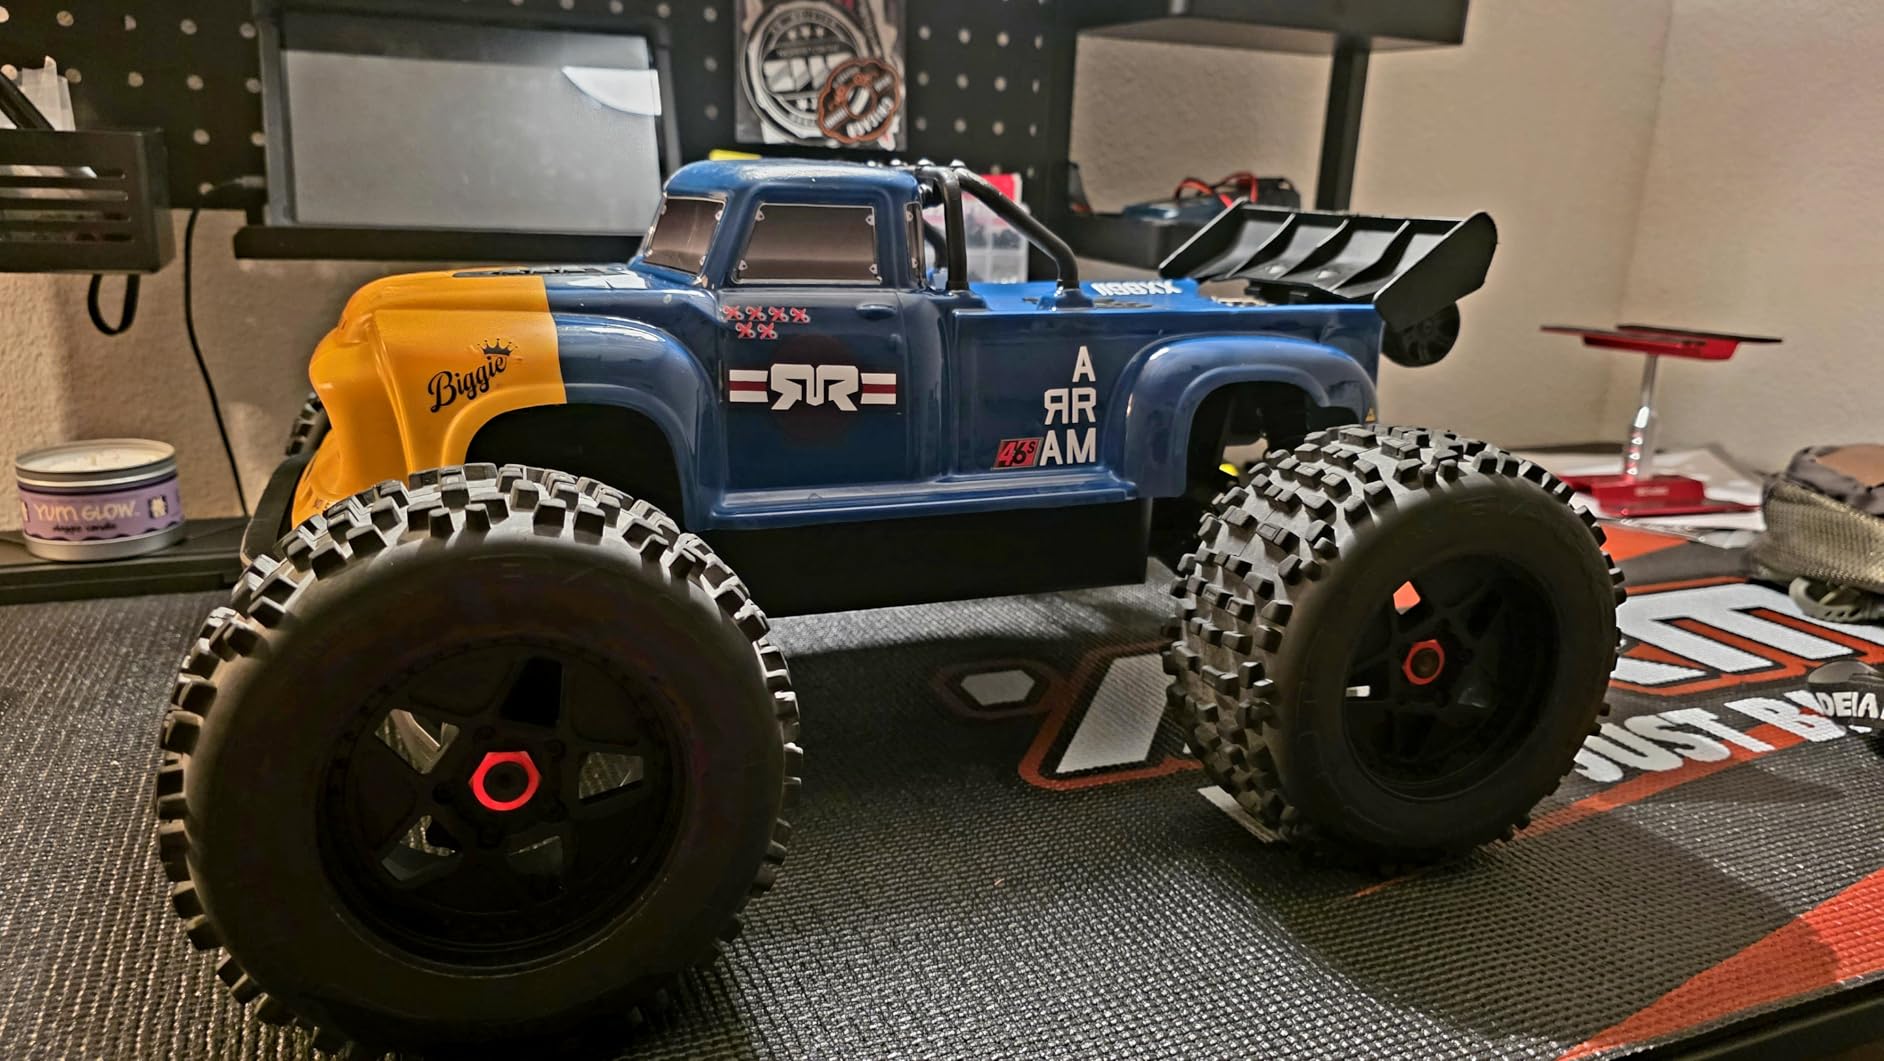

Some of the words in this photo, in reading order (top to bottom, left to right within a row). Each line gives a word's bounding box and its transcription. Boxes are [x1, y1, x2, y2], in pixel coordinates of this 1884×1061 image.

[427, 354, 508, 414] Biggie
[1072, 345, 1097, 382] A
[1039, 427, 1097, 467] AM
[1573, 707, 1777, 784] JUST
